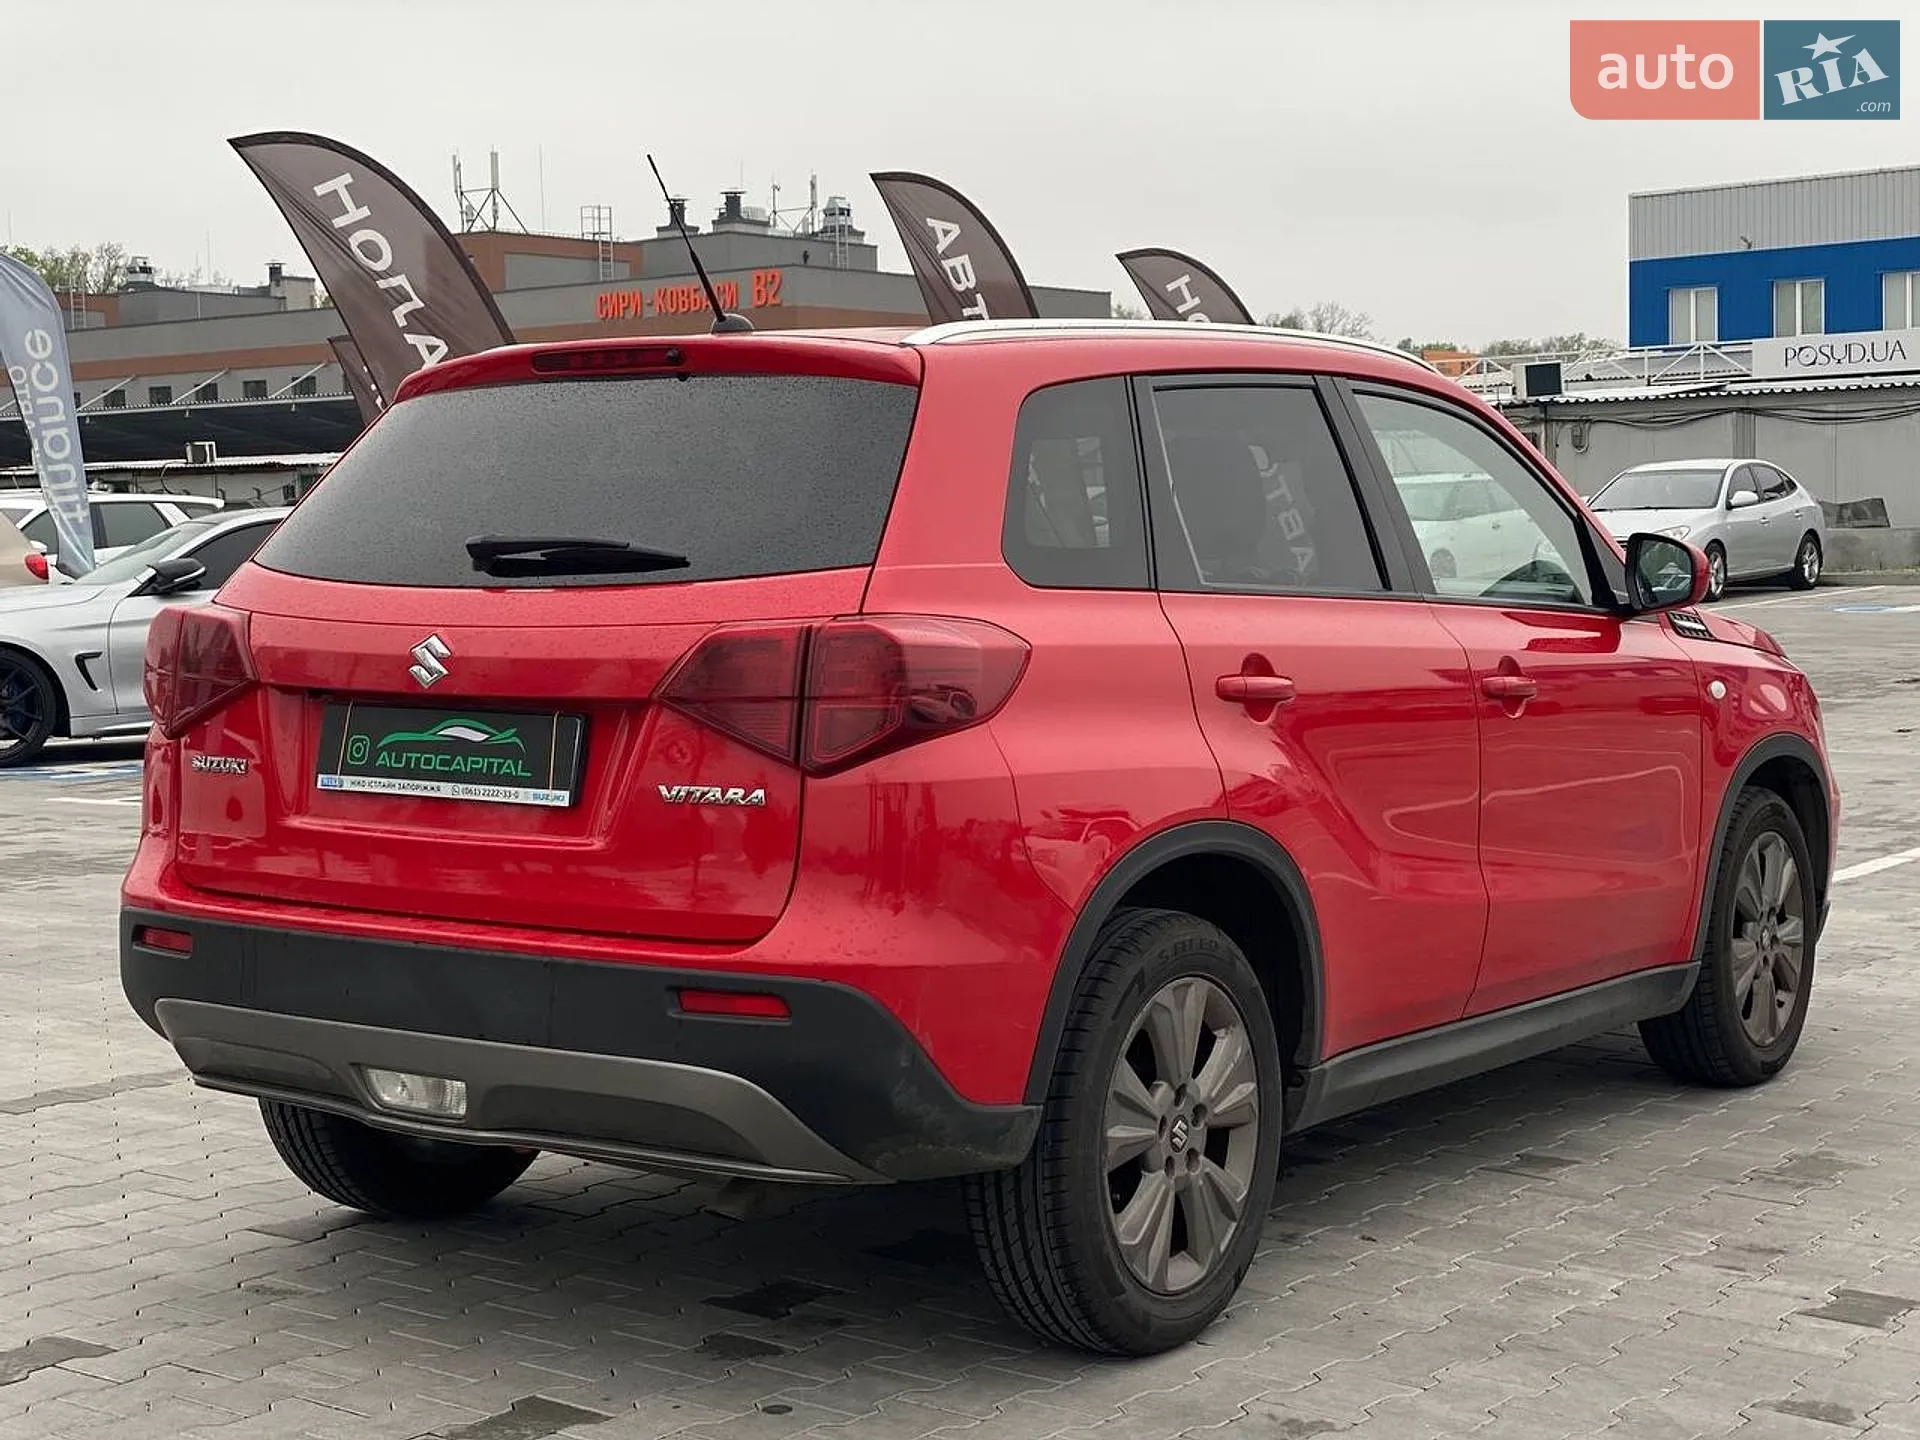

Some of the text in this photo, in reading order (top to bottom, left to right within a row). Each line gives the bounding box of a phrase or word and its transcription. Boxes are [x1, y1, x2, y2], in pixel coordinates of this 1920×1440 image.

[1784, 340, 1907, 368] POSUD.UA
[191, 755, 249, 775] SUZUKI
[375, 751, 534, 778] AUTOCAPITAL
[658, 784, 766, 806] VITARA
